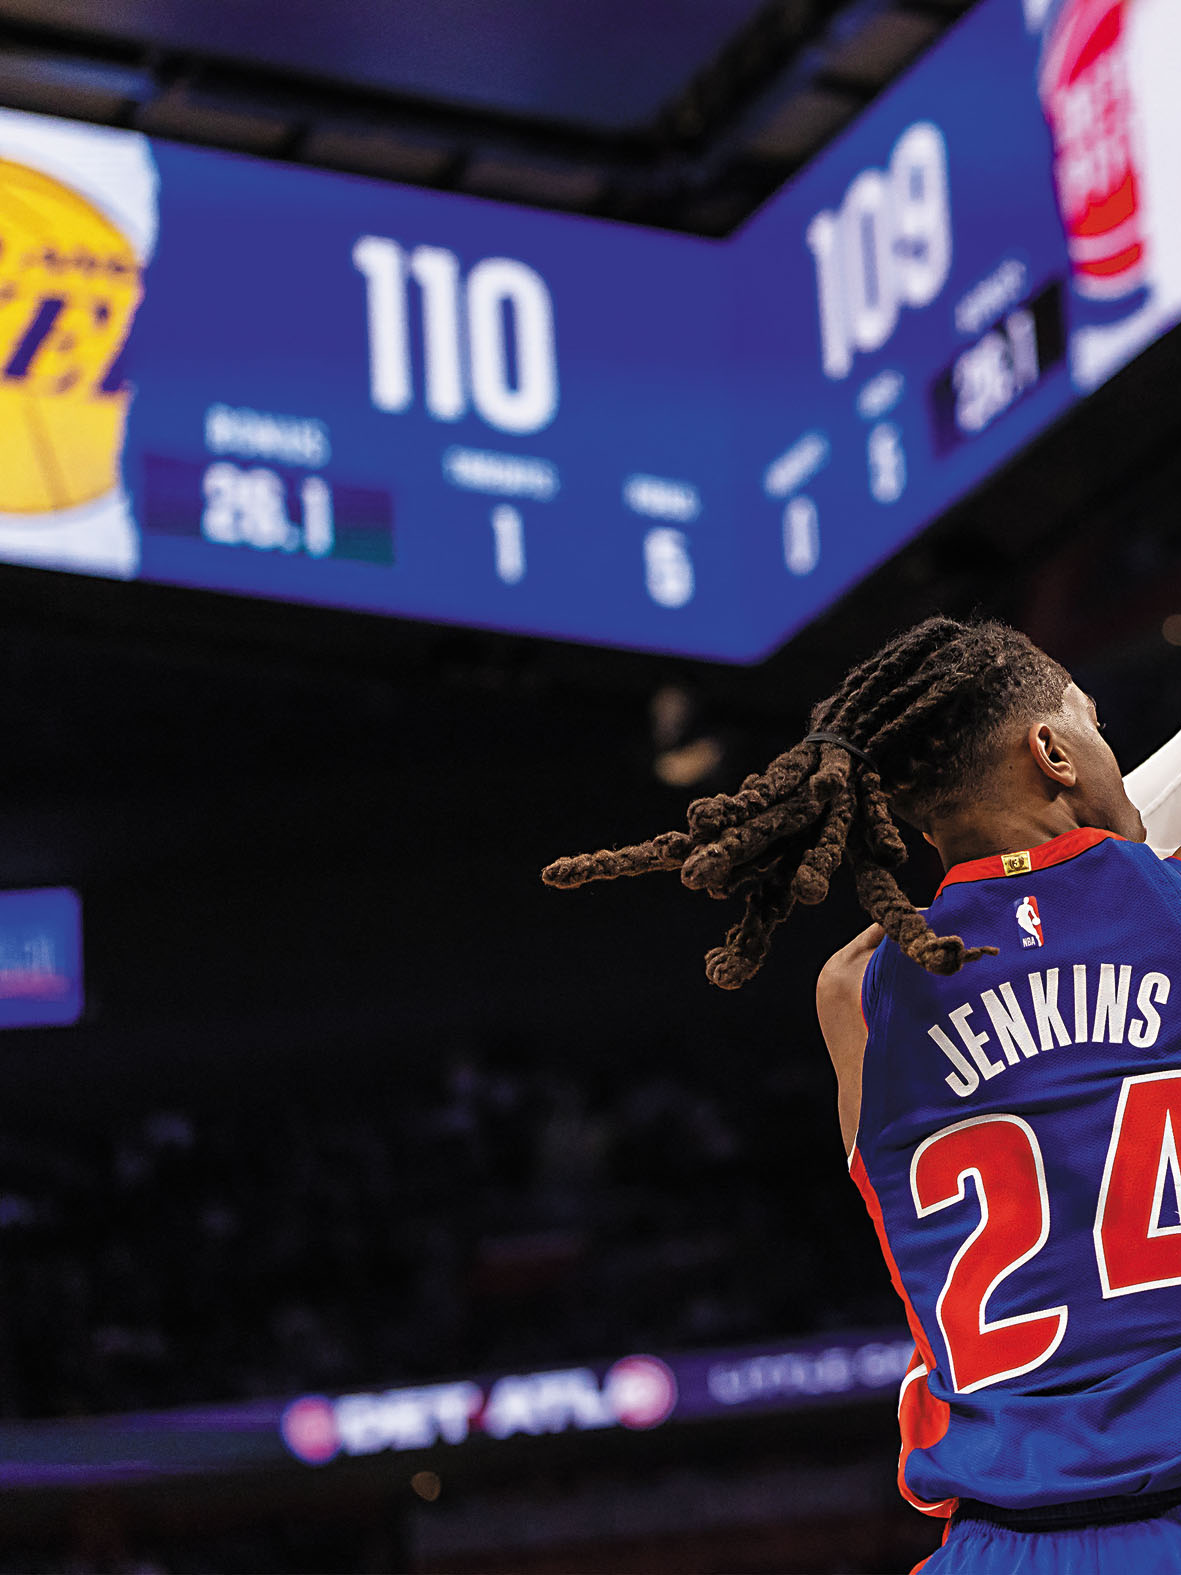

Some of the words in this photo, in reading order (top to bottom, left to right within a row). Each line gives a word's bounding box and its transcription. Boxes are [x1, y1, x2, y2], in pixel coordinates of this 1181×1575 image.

[806, 120, 952, 379] 109
[352, 235, 559, 434] 110
[491, 503, 527, 586] 1
[1022, 936, 1036, 948] NBA
[927, 963, 1171, 1098] JENKINS
